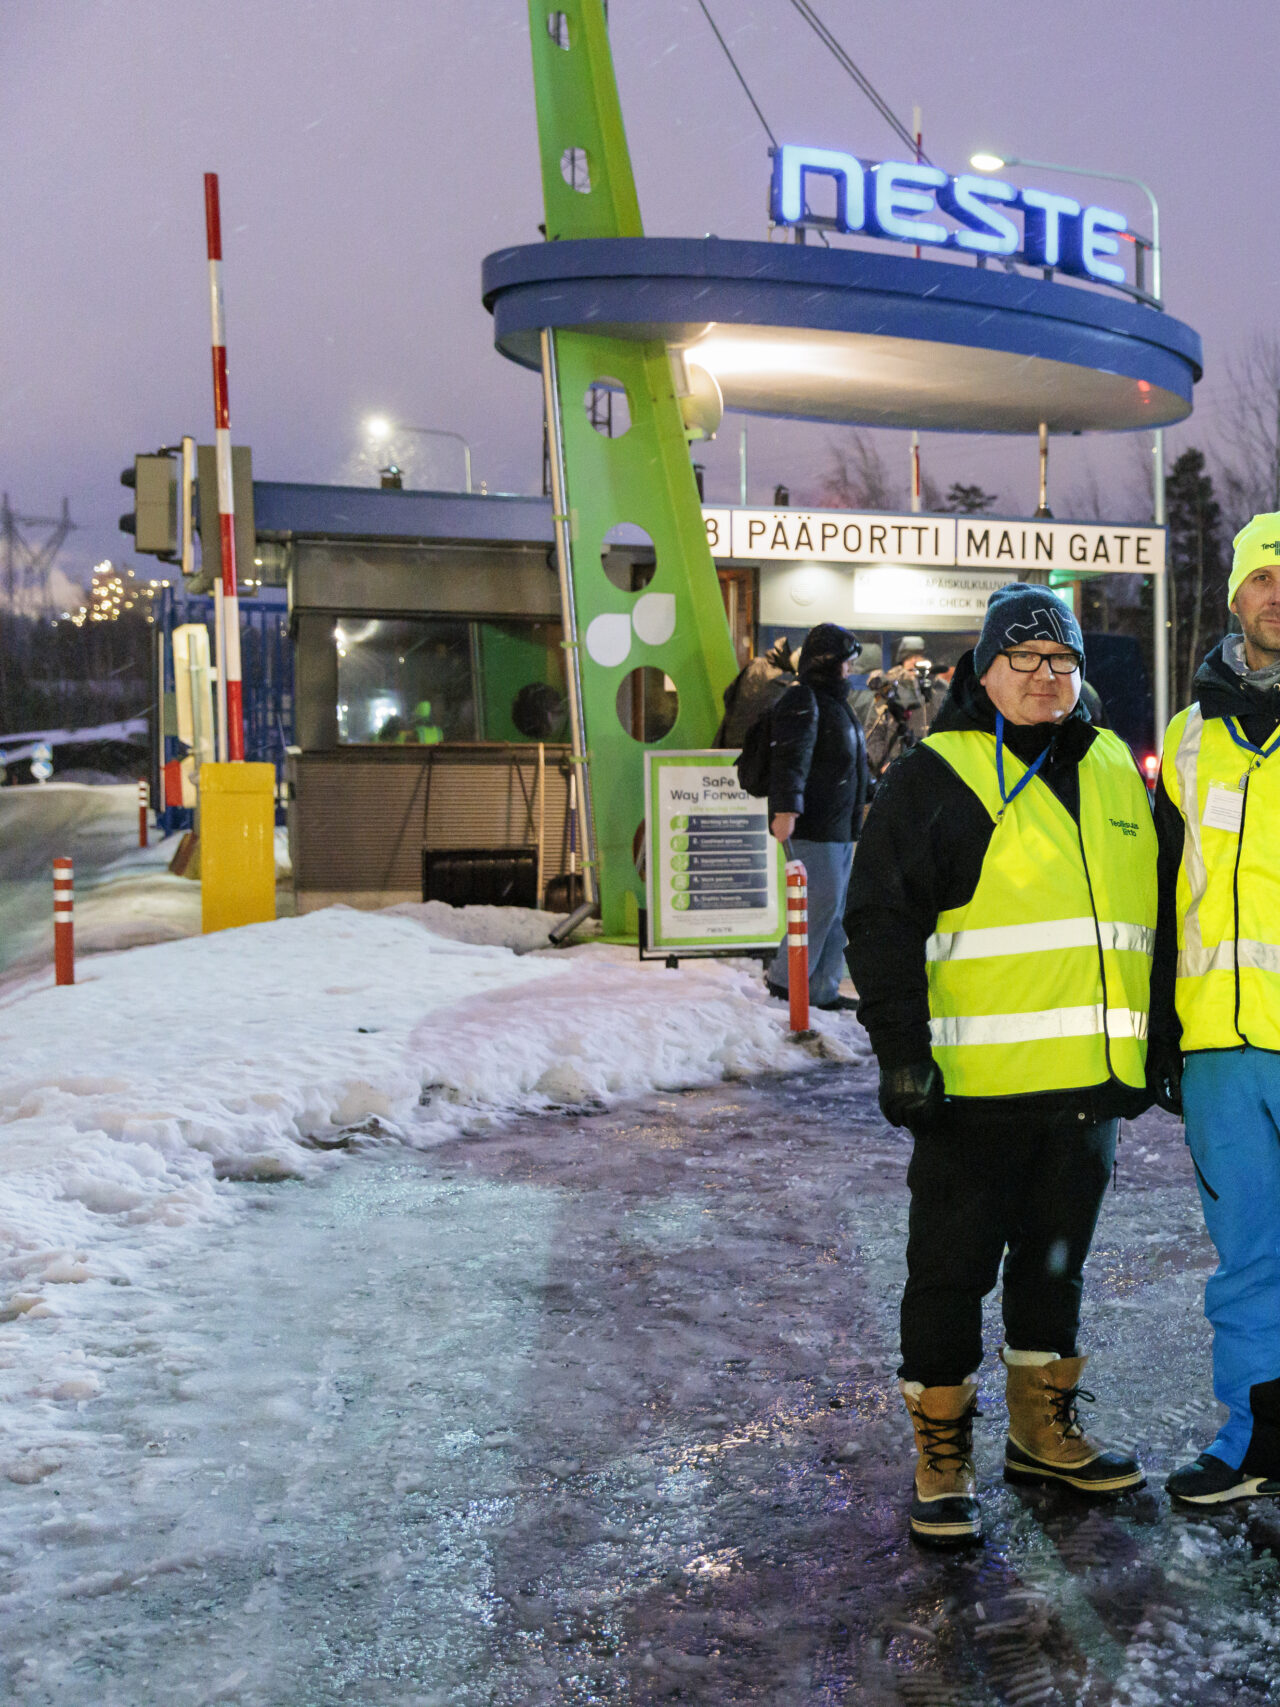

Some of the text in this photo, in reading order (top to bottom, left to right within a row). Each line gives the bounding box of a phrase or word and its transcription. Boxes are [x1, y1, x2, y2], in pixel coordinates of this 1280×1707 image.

[779, 144, 1128, 284] NESTE
[748, 515, 939, 556] PÄÄPORTTI
[966, 528, 1152, 565] MAIN GATE
[938, 599, 971, 608] CHECK
[976, 600, 986, 608] IN
[702, 776, 735, 787] Safe
[670, 789, 750, 804] Way Forwar
